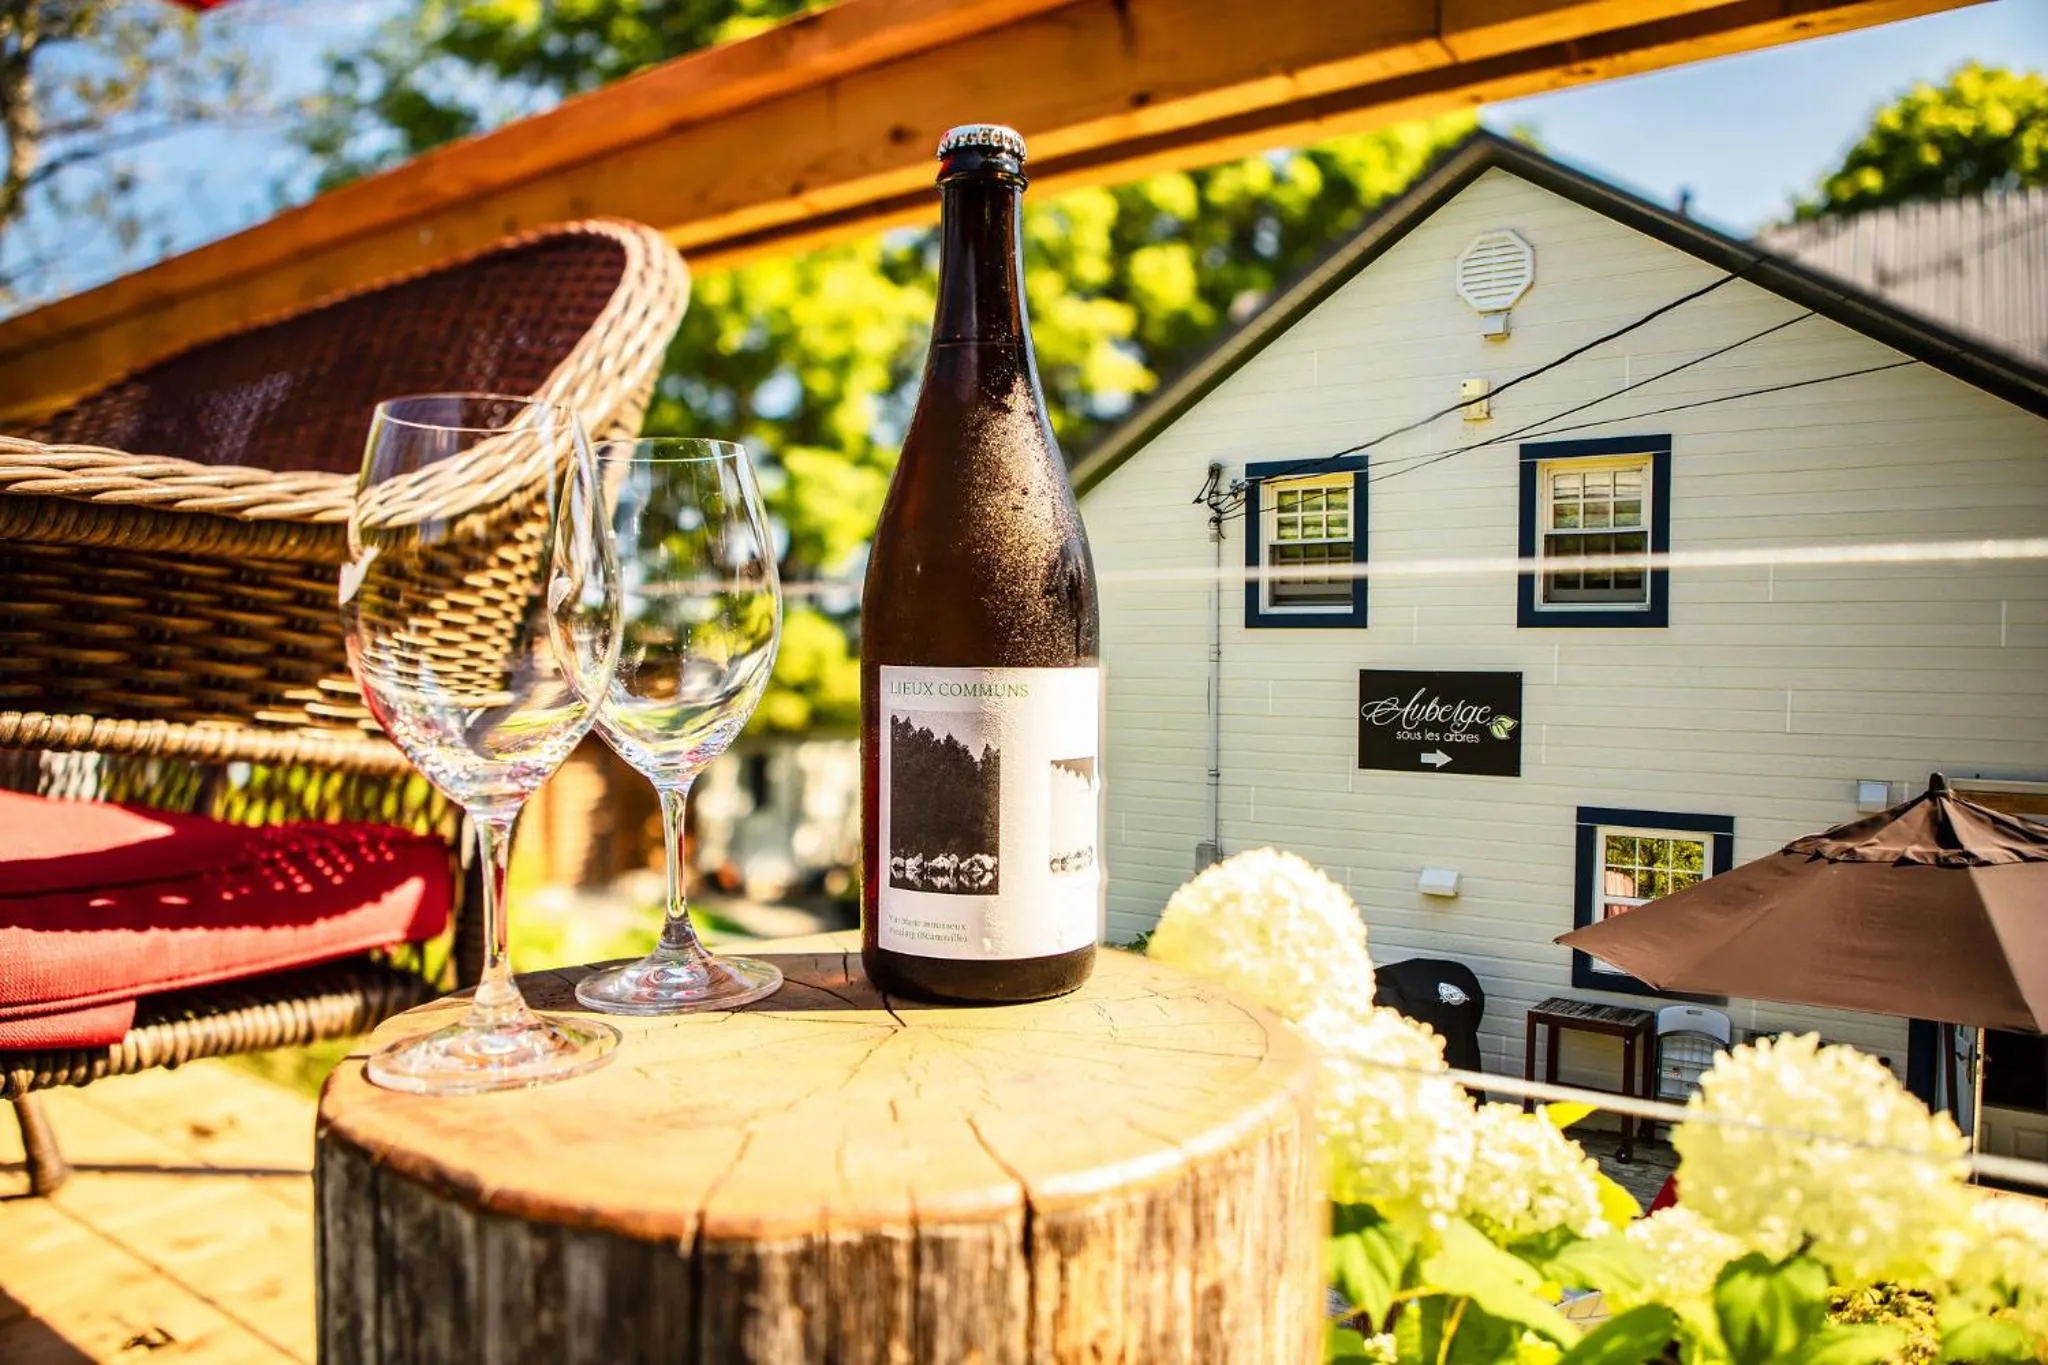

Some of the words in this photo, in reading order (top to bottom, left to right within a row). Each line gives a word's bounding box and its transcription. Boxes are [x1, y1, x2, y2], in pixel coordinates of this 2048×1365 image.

[890, 681, 934, 697] LIEUX
[938, 682, 1030, 699] COMMUNS
[1361, 687, 1492, 733] Auberge
[1396, 730, 1422, 741] sous
[1424, 728, 1440, 742] les
[1443, 731, 1480, 744] arbres
